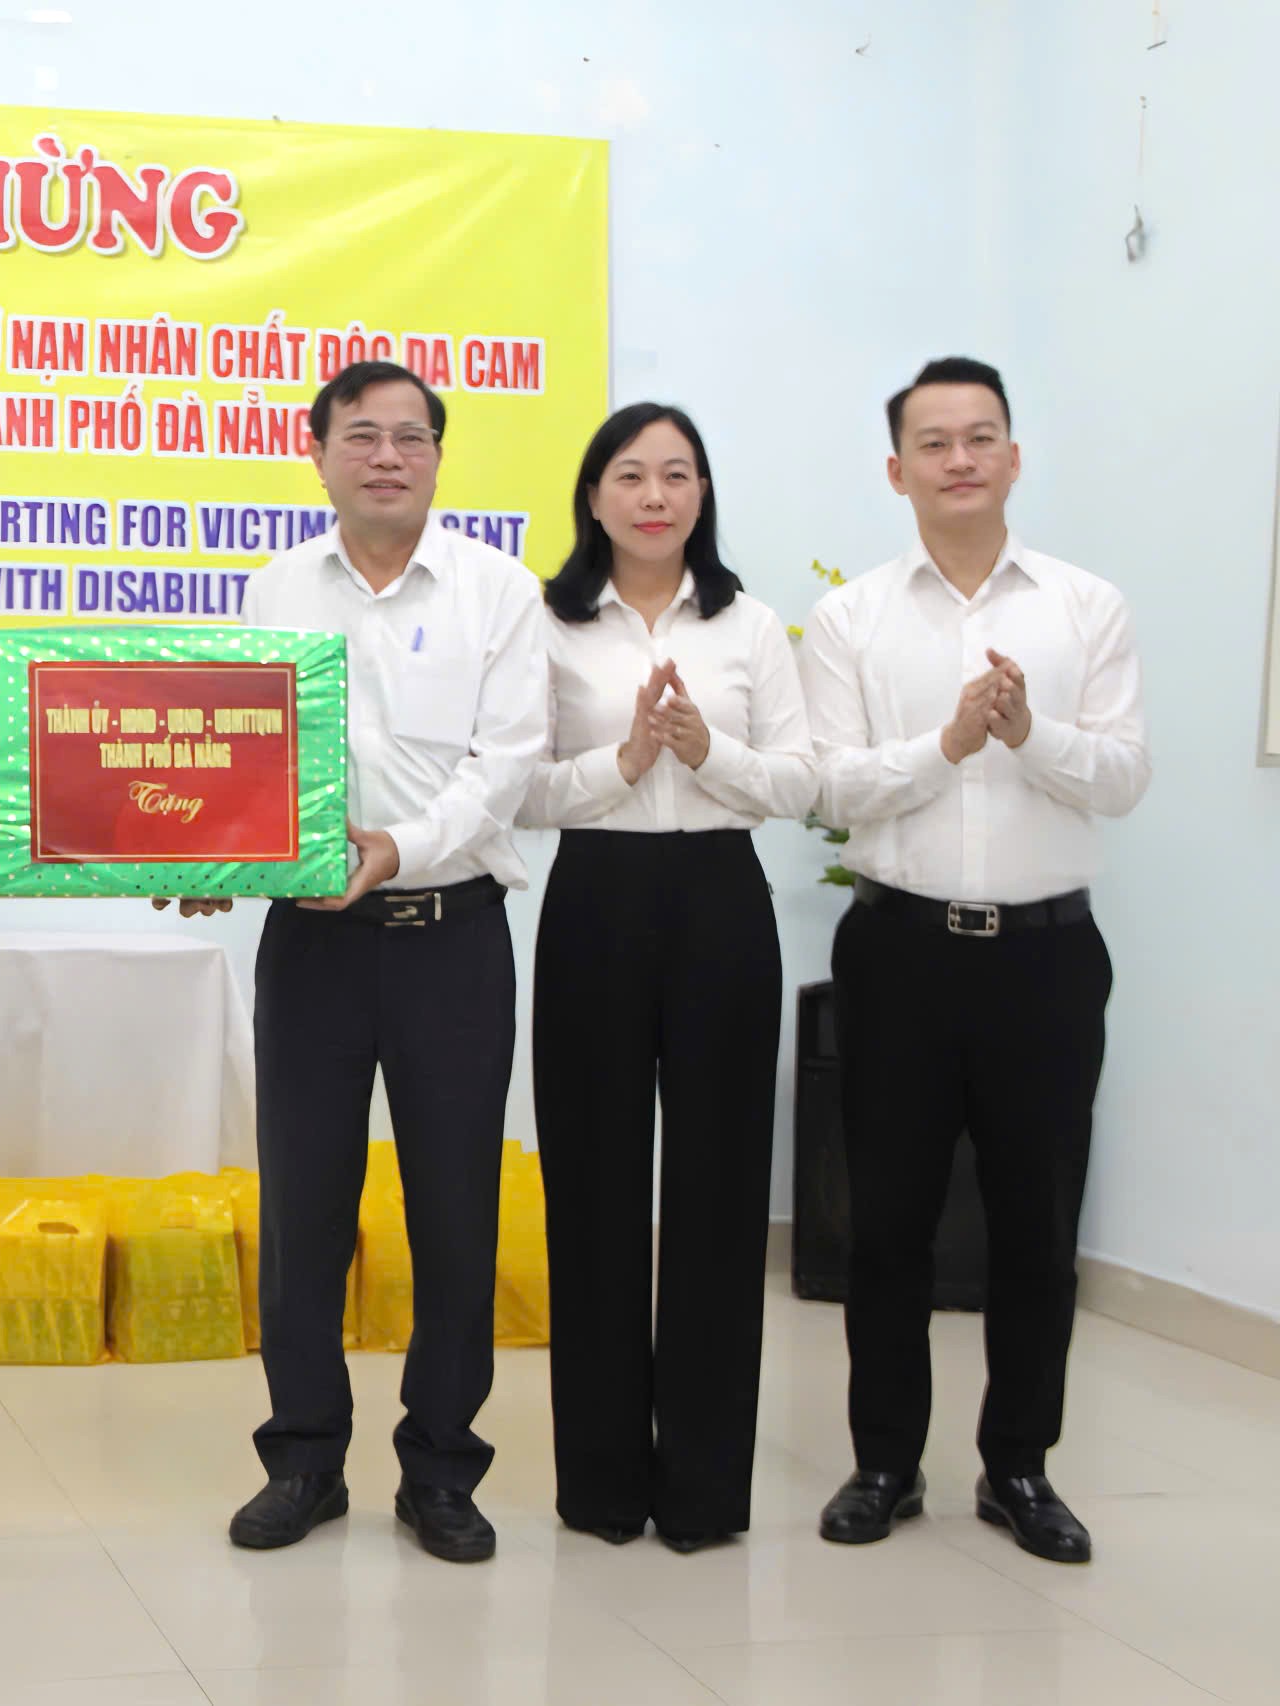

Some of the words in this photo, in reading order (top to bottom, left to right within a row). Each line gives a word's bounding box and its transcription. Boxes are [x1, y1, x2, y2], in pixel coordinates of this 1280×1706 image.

[11, 319, 84, 381] NẠN
[99, 317, 197, 376] NHÂN
[211, 313, 306, 380] CHẤT
[407, 337, 451, 386] DA
[465, 340, 540, 390] CAM
[70, 385, 142, 451] PHỐ
[155, 396, 205, 453] ĐÀ
[123, 505, 187, 547] FOR
[200, 506, 338, 550] VICTIM
[78, 569, 250, 615] DISABILIT
[99, 737, 143, 768] THÀNH
[128, 780, 204, 824] Tặng
